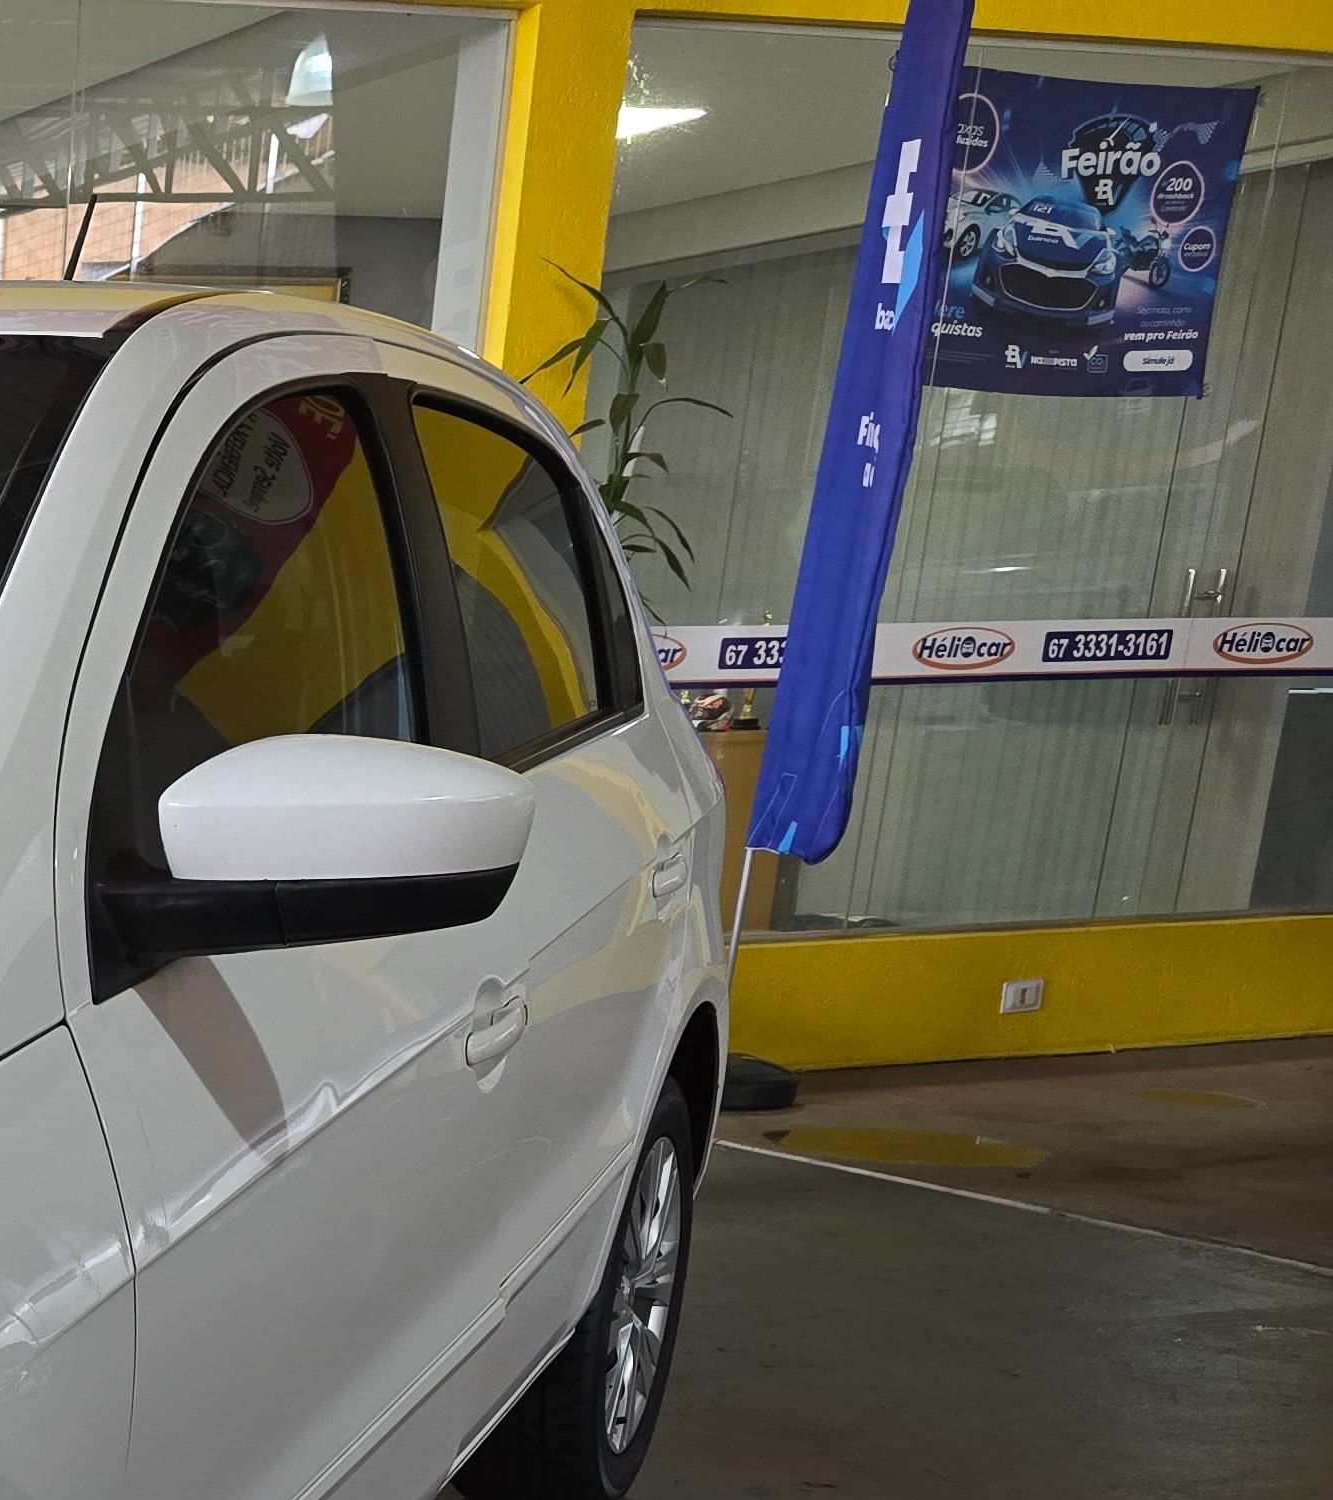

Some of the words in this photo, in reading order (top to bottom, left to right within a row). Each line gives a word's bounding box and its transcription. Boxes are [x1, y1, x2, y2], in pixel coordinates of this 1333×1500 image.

[1061, 141, 1161, 178] Feirão
[1166, 178, 1193, 191] 200
[931, 320, 983, 338] quistas
[1124, 332, 1145, 341] vem
[1145, 332, 1165, 343] pro
[1166, 328, 1199, 340] Feirão
[725, 644, 750, 666] 67
[1049, 638, 1069, 658] 67
[1073, 632, 1169, 658] 3331-3161
